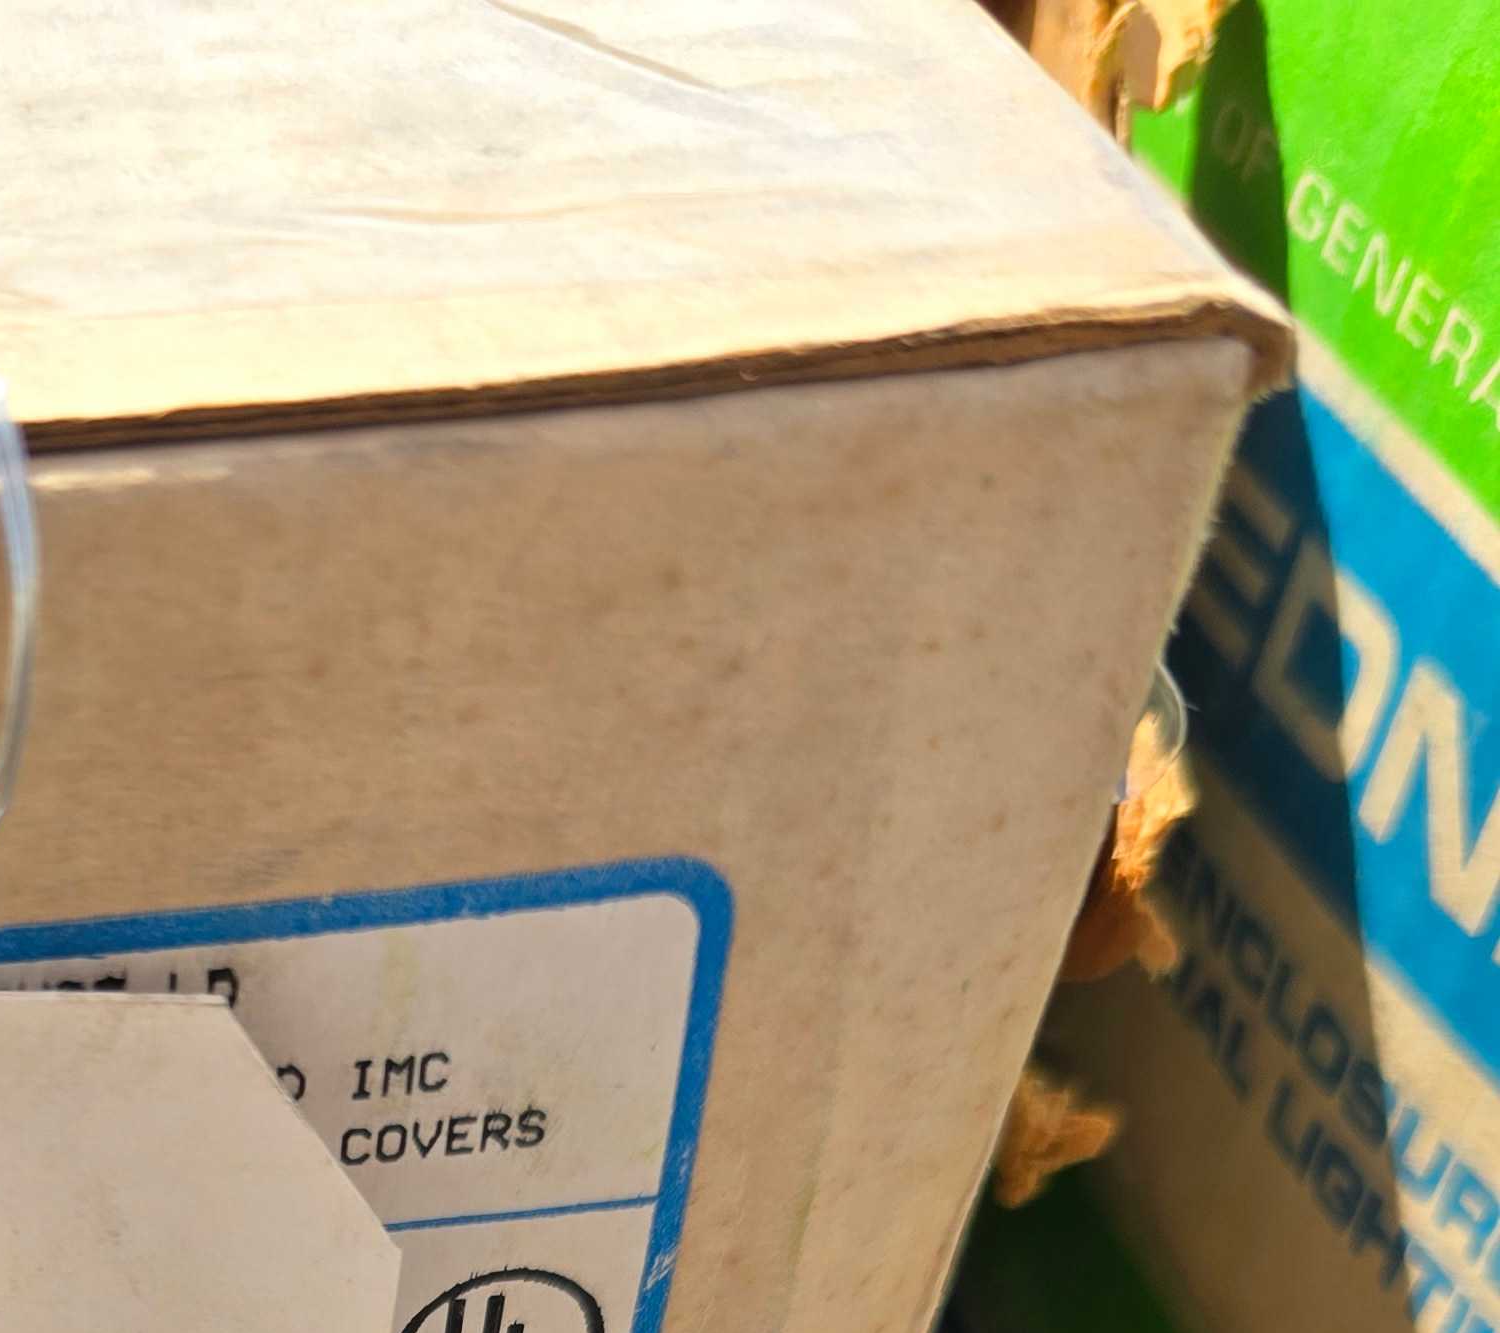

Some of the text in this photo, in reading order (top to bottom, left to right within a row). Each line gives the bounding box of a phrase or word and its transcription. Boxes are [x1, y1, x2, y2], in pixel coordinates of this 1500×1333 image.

[1182, 455, 1500, 970] EDN
[340, 1107, 546, 1165] COVERS
[352, 1051, 450, 1100] IMC
[1158, 822, 1500, 1295] NCLOSUR
